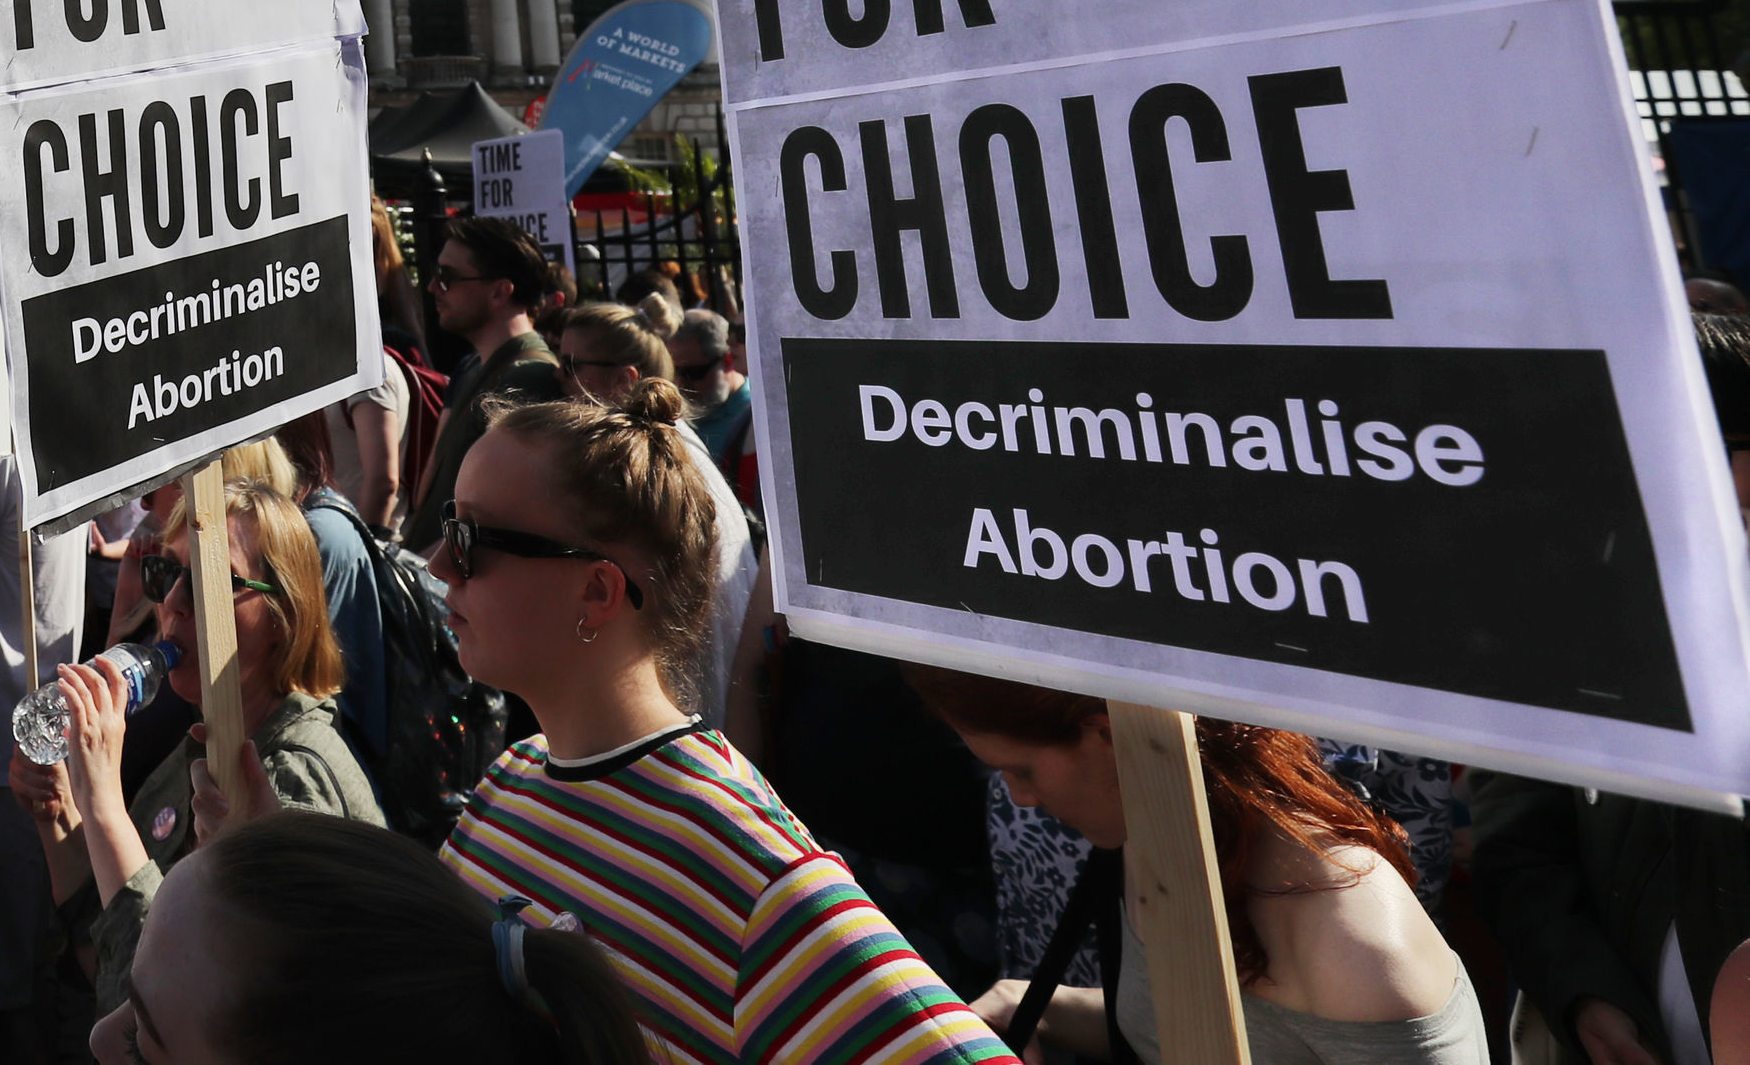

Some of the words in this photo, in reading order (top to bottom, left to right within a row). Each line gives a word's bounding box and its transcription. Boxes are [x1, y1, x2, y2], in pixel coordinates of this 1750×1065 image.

[596, 36, 617, 49] OF
[619, 42, 686, 74] MARKETS
[613, 27, 624, 38] A
[628, 31, 680, 57] WORLD
[22, 80, 300, 278] CHOICE
[479, 142, 522, 174] TIME
[480, 178, 514, 209] FOR
[780, 66, 1395, 322] CHOICE
[71, 261, 320, 364] Decriminalise
[128, 347, 284, 430] Abortion
[859, 385, 1484, 487] Decriminalise
[963, 508, 1369, 623] Abortion
